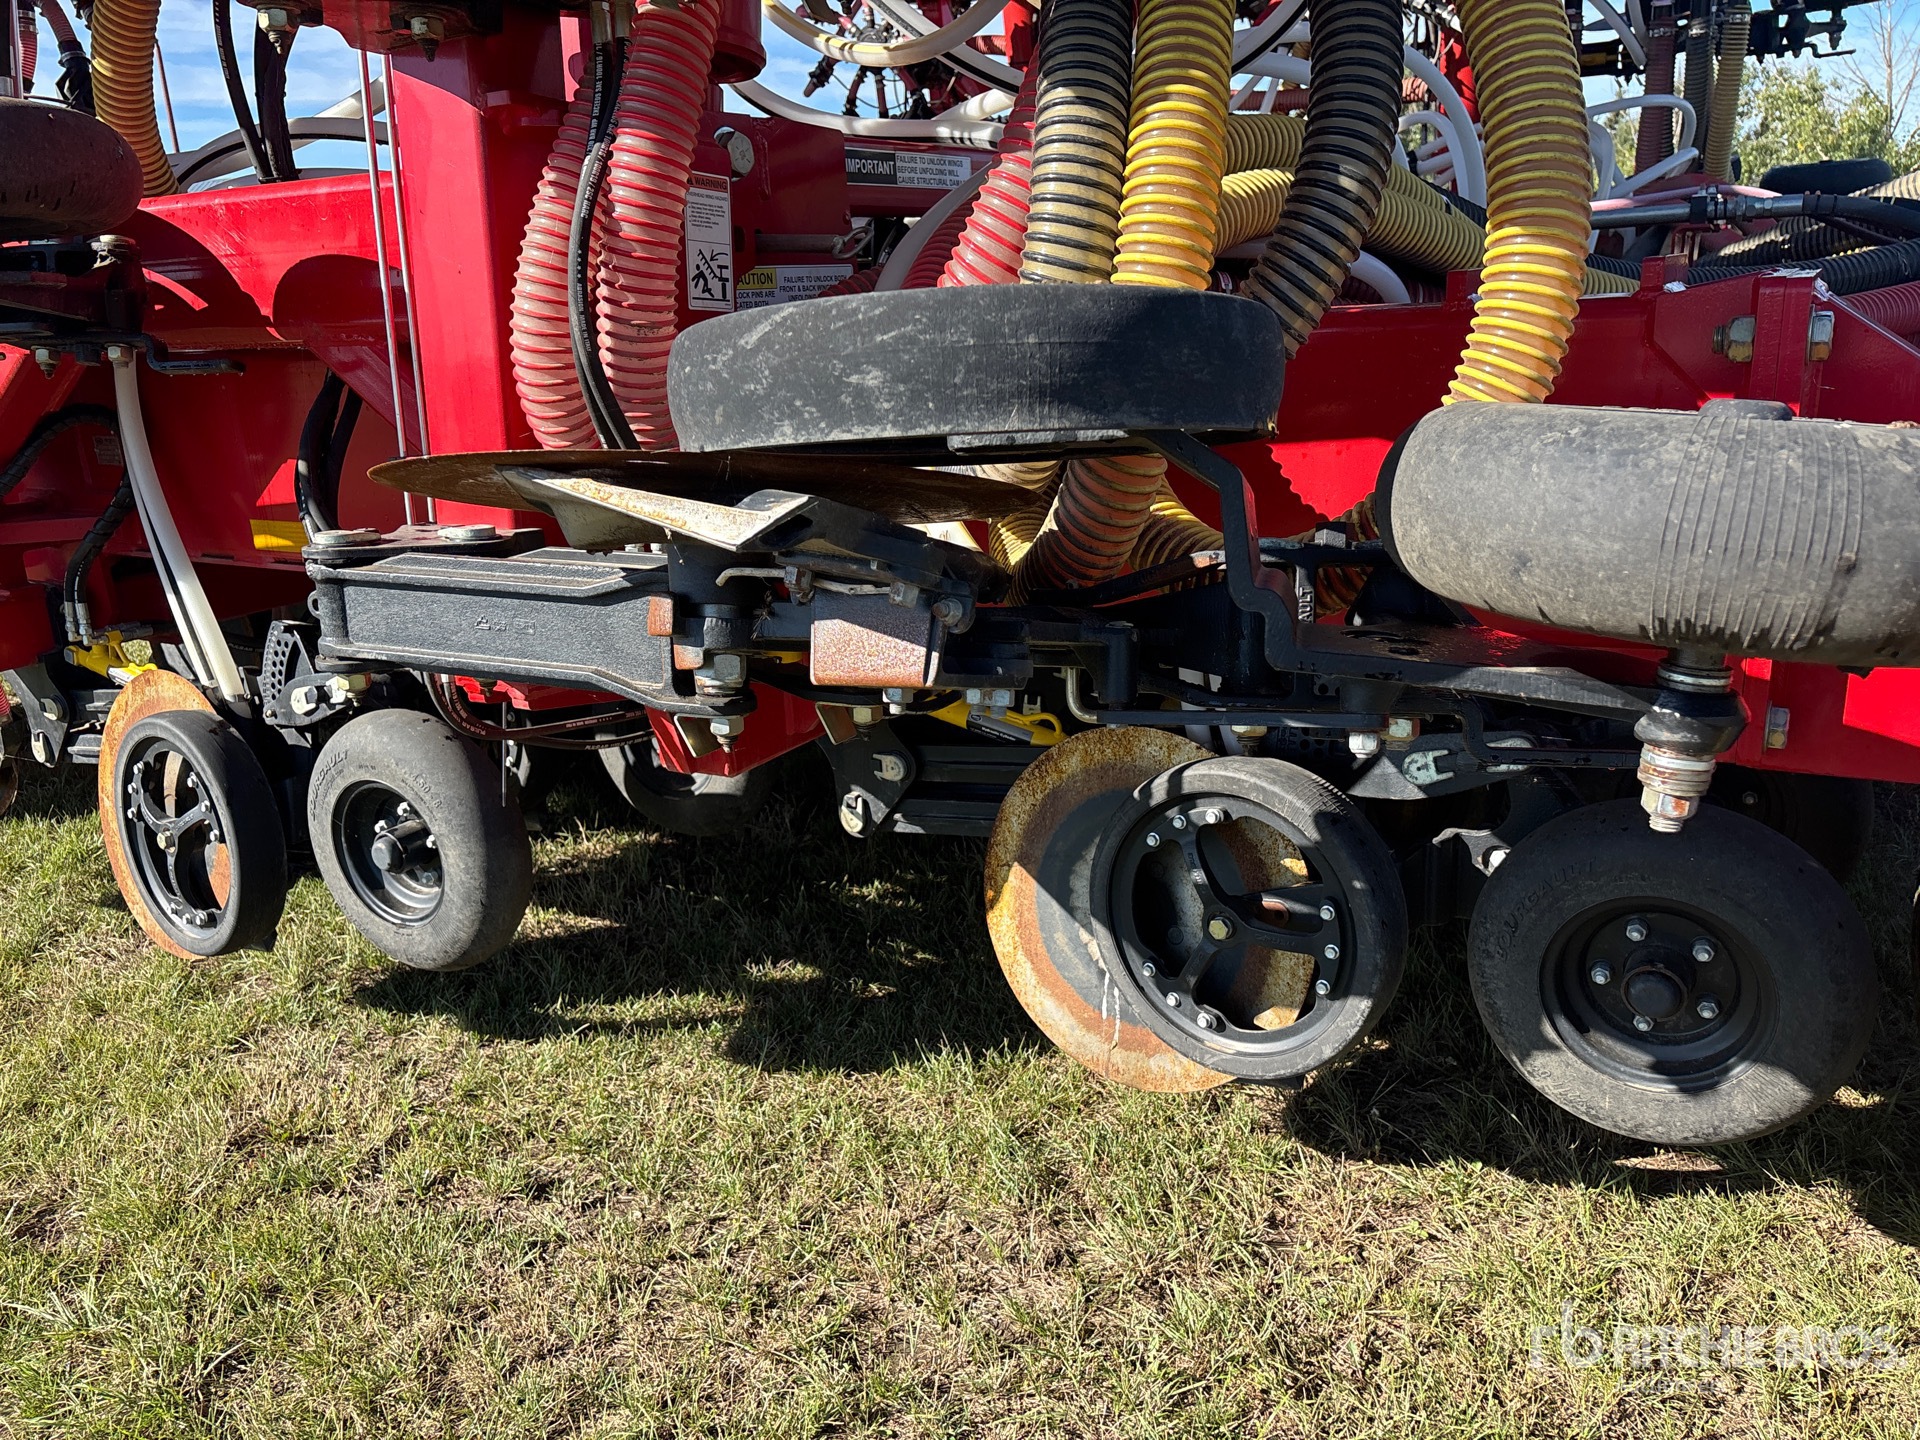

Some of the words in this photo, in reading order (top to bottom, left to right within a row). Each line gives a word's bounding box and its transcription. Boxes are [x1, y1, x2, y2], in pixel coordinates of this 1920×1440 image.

[595, 80, 603, 92] SAE
[593, 93, 602, 116] EXCEEDS
[844, 158, 895, 175] IMPORTANT
[896, 155, 918, 164] FAILURE
[919, 157, 926, 165] TO
[926, 157, 947, 167] UNLOCK
[947, 159, 963, 168] WINGS
[897, 165, 918, 174] BEFORE
[919, 167, 947, 176] UNFOLDING
[947, 168, 960, 177] WILL
[694, 177, 728, 190] WARNING
[897, 176, 916, 184] CAUSE
[916, 177, 948, 186] STRUCTURAL
[584, 187, 595, 200] 2SC
[737, 272, 773, 285] AUTION
[783, 276, 805, 284] FAILURE
[806, 275, 813, 283] TO
[813, 275, 834, 283] UNLOCK
[751, 290, 764, 299] PINS
[764, 290, 776, 298] ARE
[779, 285, 797, 293] FRONT
[802, 284, 817, 292] BACK
[817, 284, 832, 292] WIN
[576, 283, 584, 312] ABRASION
[754, 300, 769, 308] BOTH
[579, 314, 588, 331] MADE
[583, 331, 589, 339] IN
[584, 339, 593, 352] ITALY
